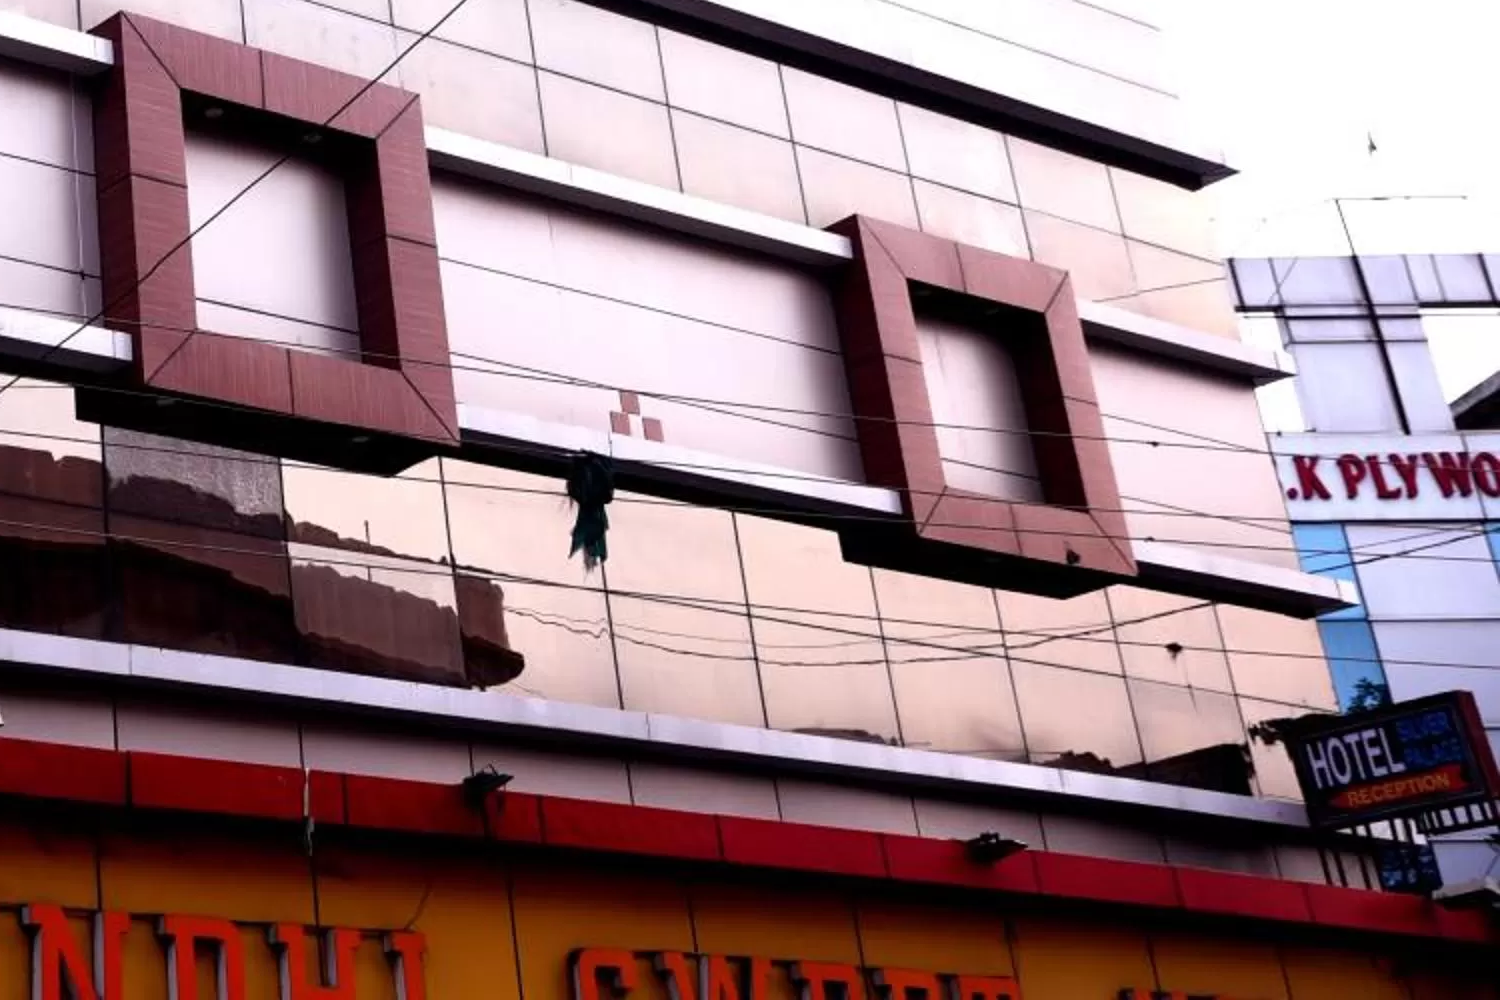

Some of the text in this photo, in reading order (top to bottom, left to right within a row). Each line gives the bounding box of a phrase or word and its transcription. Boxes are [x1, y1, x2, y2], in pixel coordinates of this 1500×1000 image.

[1336, 452, 1500, 500] PLYWO
[1306, 728, 1407, 790] HOTEL
[1347, 772, 1450, 808] RECEPTION
